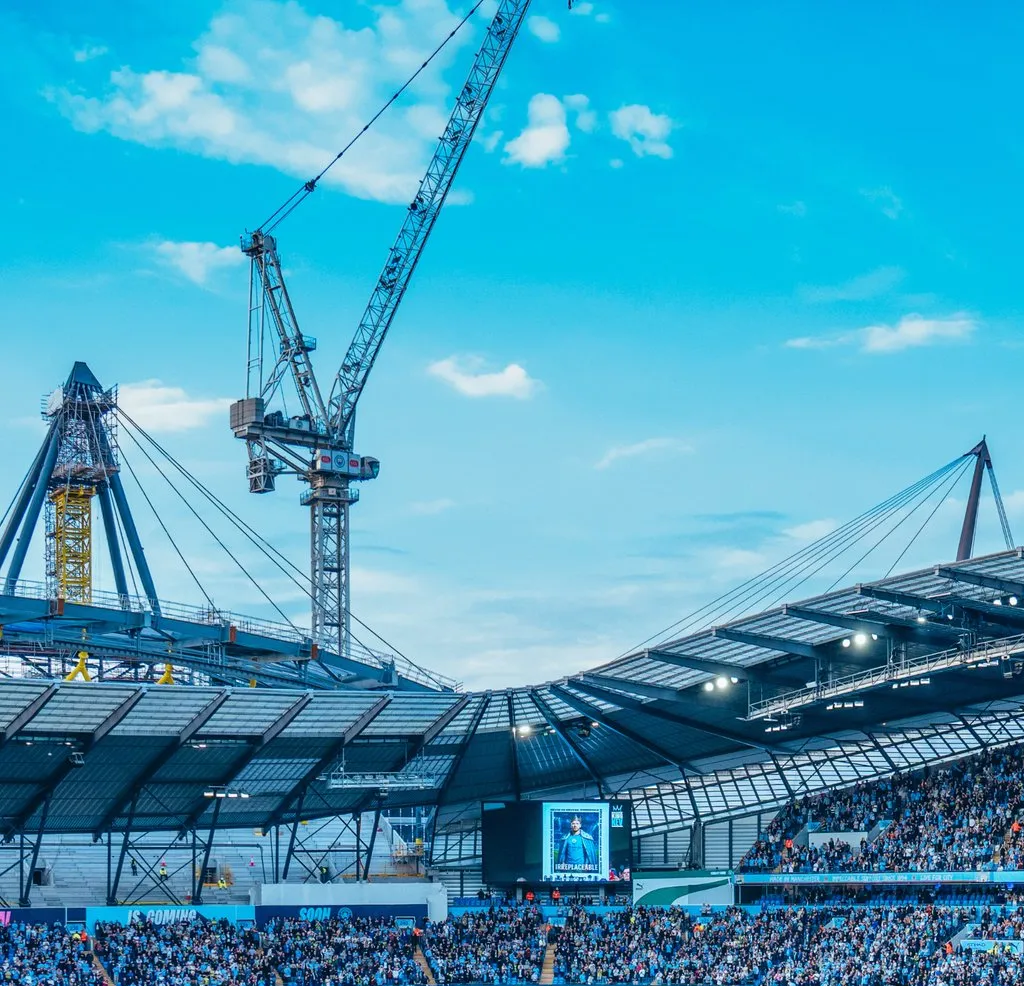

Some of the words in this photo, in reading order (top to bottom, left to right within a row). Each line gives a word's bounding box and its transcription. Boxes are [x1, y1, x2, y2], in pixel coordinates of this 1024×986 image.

[555, 863, 598, 871] IRREPLACEABLE
[127, 909, 141, 925] IS
[146, 909, 197, 925] COMING
[300, 907, 331, 922] SOON
